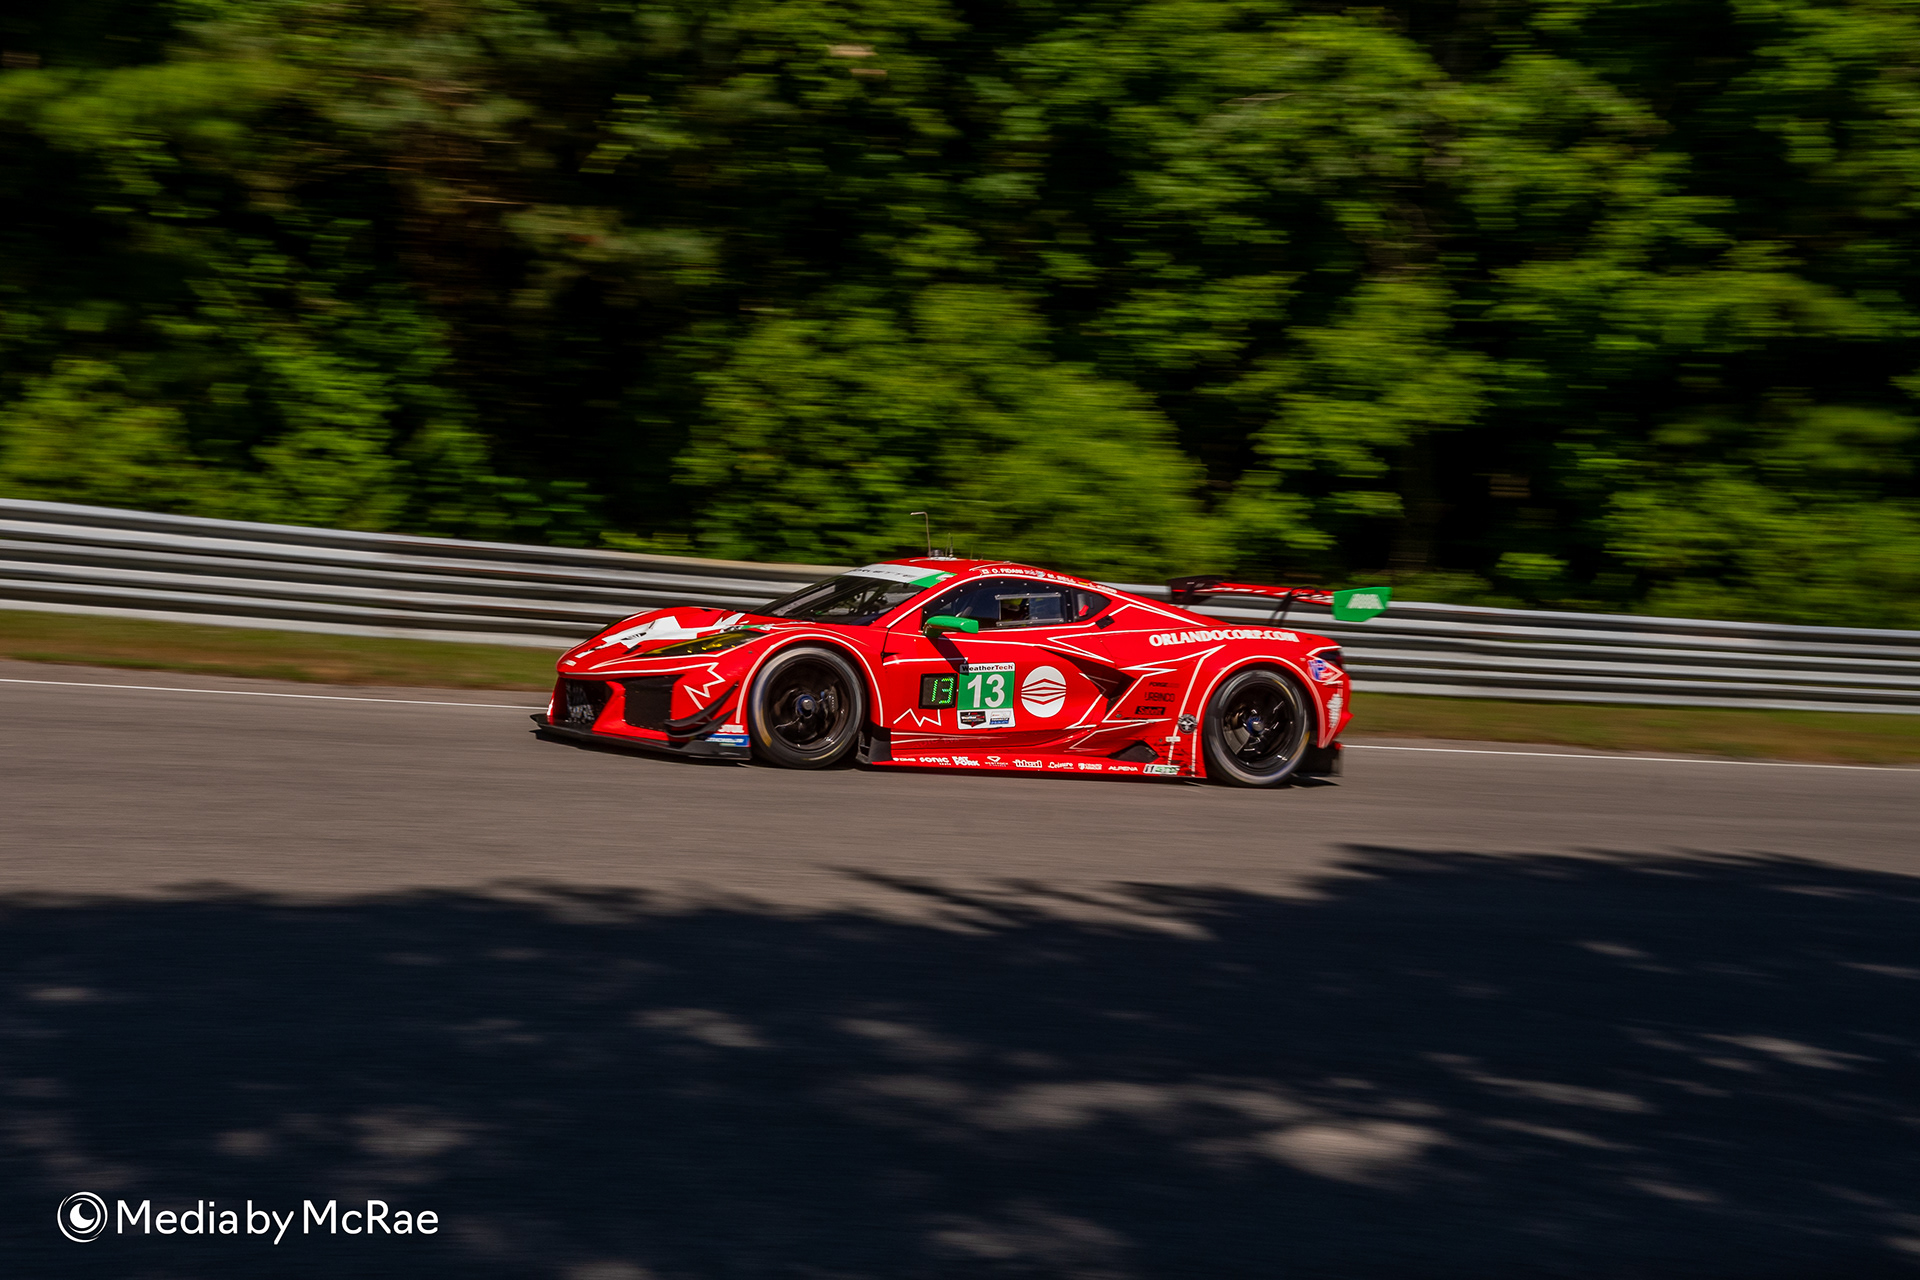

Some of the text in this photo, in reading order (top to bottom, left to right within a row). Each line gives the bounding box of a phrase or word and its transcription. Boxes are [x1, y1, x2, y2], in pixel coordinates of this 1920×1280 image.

[1149, 629, 1300, 647] ORLANDOCORP.COM
[931, 677, 954, 704] 13
[967, 674, 1005, 708] 13
